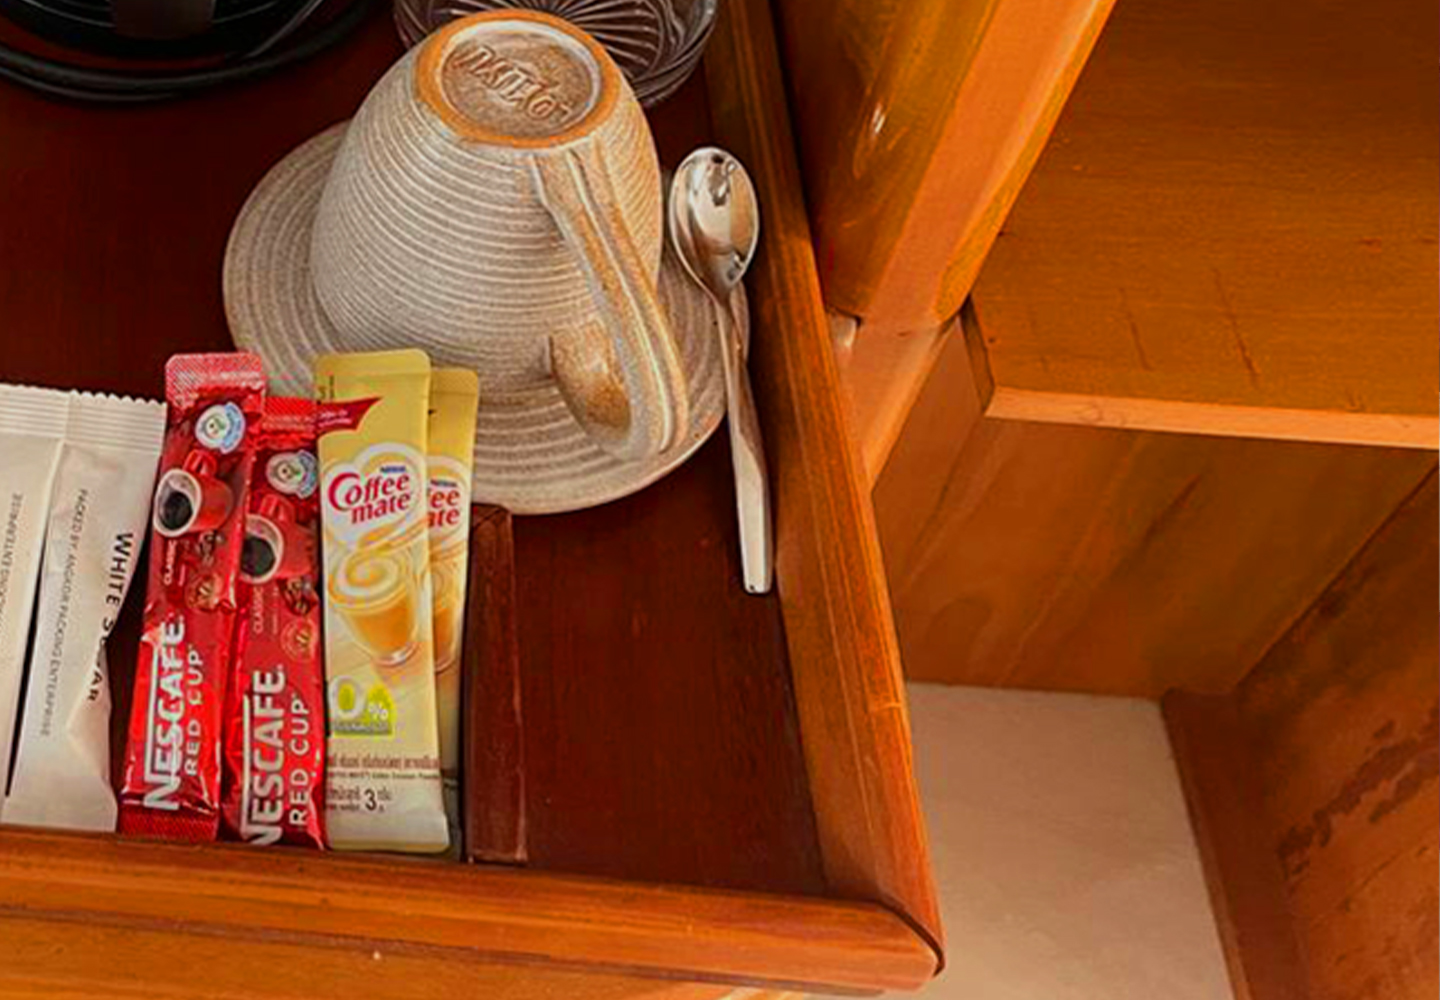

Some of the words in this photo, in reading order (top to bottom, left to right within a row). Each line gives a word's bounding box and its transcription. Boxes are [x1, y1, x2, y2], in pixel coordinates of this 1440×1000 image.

[327, 472, 410, 512] Coffee
[351, 493, 411, 525] mate
[428, 508, 461, 529] ate
[0, 493, 24, 567] ENTERPRISE
[105, 532, 134, 605] WHITE
[186, 650, 203, 706] CUP
[185, 719, 202, 776] RED
[291, 699, 310, 756] CUP
[289, 768, 310, 826] RED
[364, 788, 378, 812] 3
